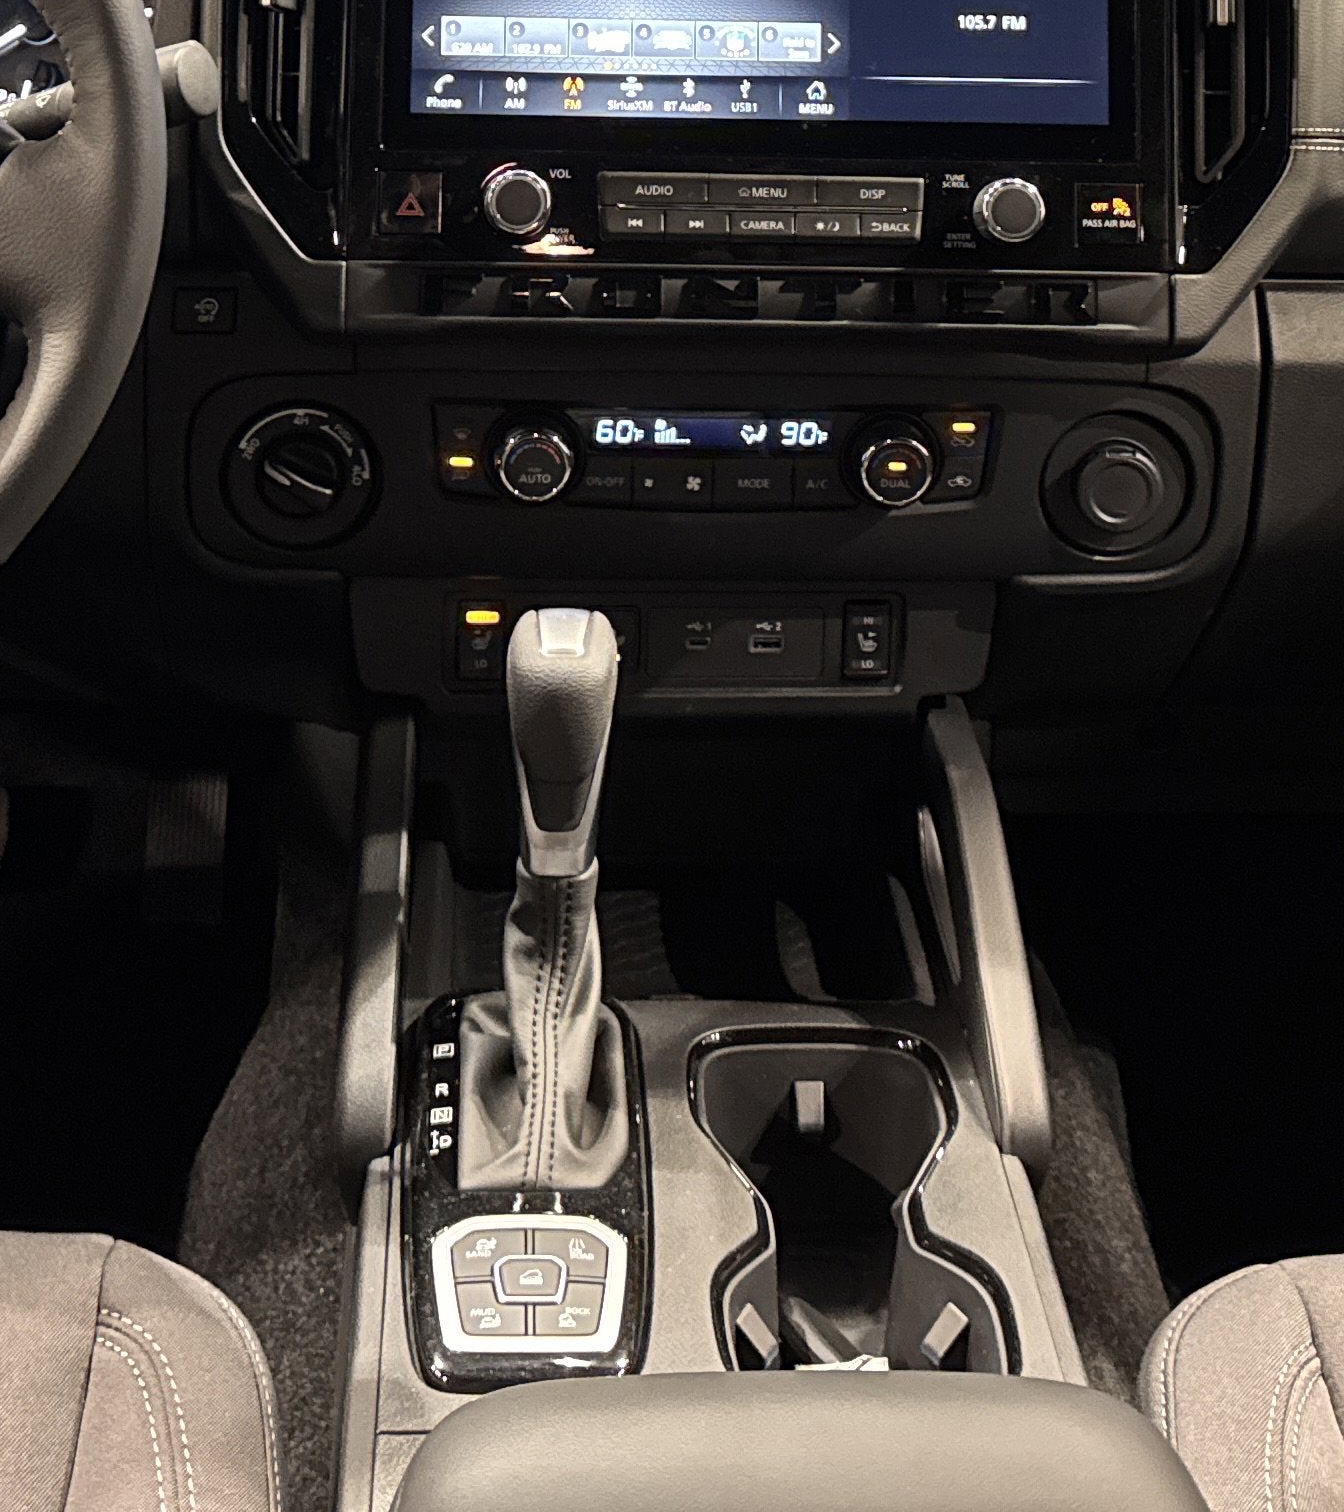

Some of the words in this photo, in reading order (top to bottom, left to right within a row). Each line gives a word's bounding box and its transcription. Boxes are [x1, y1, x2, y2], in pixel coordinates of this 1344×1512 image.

[957, 14, 997, 30] 105.7
[1002, 15, 1027, 31] FM
[426, 96, 462, 110] Phone
[504, 97, 525, 110] AM
[563, 99, 582, 111] FM
[731, 102, 758, 113] USB1
[798, 103, 834, 115] MENU
[549, 168, 572, 179] VOL
[945, 174, 966, 182] TUNE
[635, 185, 674, 196] AUDIO
[942, 181, 969, 189] SCROLL
[751, 188, 788, 199] MENU
[860, 189, 886, 199] DISP
[1091, 202, 1109, 212] OFF
[740, 220, 785, 231] CAMERA
[882, 222, 910, 233] BACK
[1082, 219, 1103, 228] PASS
[1103, 219, 1118, 228] AIR
[1119, 219, 1137, 229] BAG
[420, 272, 1100, 326] FRONTIER
[293, 417, 309, 426] 4H
[518, 473, 552, 484] AUTO
[737, 478, 771, 489] MODE
[805, 478, 829, 489] A/C
[879, 478, 911, 489] DUAL
[861, 659, 874, 669] LO
[434, 1082, 449, 1098] R
[439, 1134, 453, 1149] D
[470, 1307, 496, 1317] MUD
